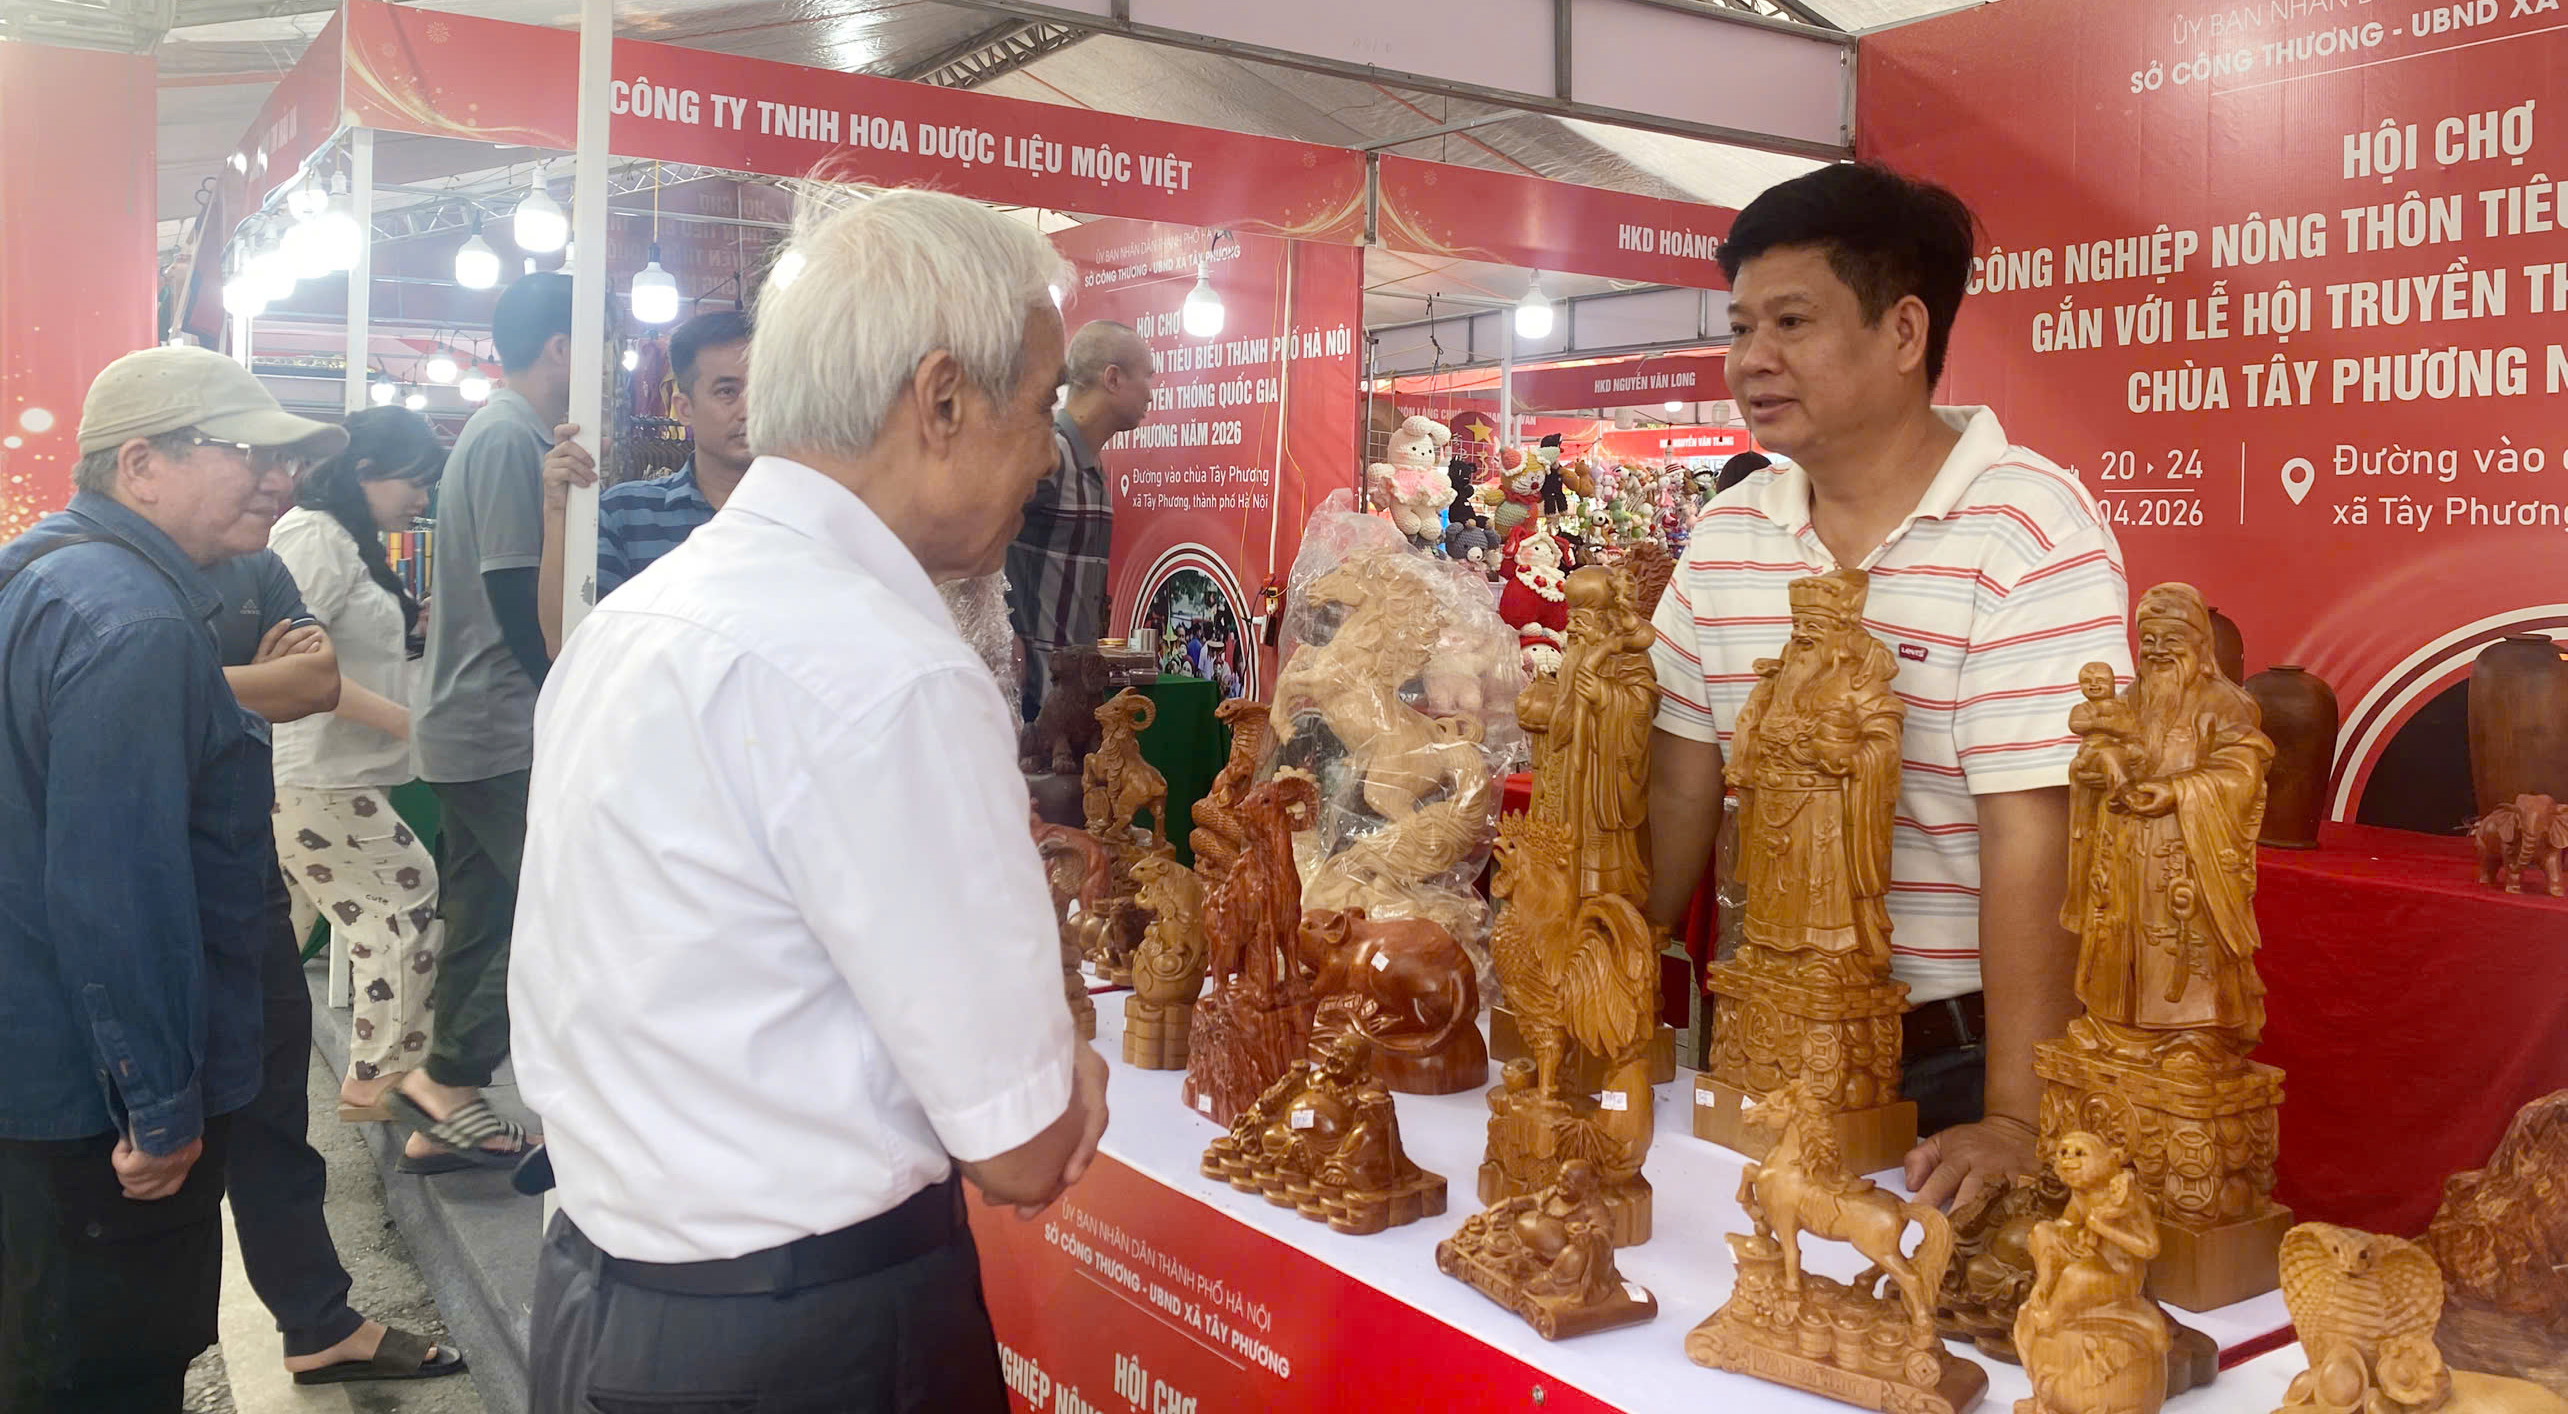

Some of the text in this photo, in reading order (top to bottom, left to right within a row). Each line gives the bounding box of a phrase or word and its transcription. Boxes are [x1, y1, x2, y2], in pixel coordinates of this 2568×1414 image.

[2210, 6, 2262, 37] BAN
[2129, 60, 2164, 94] SỞ
[2171, 51, 2254, 85] CÔNG
[2262, 21, 2384, 67] THƯƠNG
[2411, 0, 2499, 37] UBND
[610, 76, 1193, 195] CÔNG TY TNHH HOA DƯỢC LIỆU MỘC VIỆT
[2343, 99, 2536, 184] HỘI CHỢ
[1618, 223, 1719, 261] HKD HOÀNG
[1965, 245, 2053, 296] CÔNG
[2064, 223, 2199, 285] NGHIỆP
[2211, 211, 2327, 269] NÔNG
[2340, 190, 2463, 252] THÔN
[1095, 269, 1117, 285] CÔNG
[1118, 264, 1148, 280] THƯƠNG
[1153, 259, 1174, 274] UBND
[2031, 294, 2103, 353] GẮN
[2114, 293, 2173, 347] VỚI
[2186, 279, 2230, 341] LỄ
[2242, 279, 2312, 344] HỘI
[2325, 255, 2507, 330] TRUYỀN
[1136, 309, 1182, 344] HỘI CHỢ
[1167, 343, 1192, 374] TIÊU
[1195, 335, 1223, 370] BIỂU
[1226, 335, 1268, 367] THÀNH
[1302, 326, 1323, 359] HÀ
[1325, 322, 1351, 361] NỘI
[1176, 376, 1215, 410] THỐNG
[1219, 371, 1253, 409] QUỐC
[1256, 377, 1279, 404] GIA
[1594, 379, 1611, 393] HKD
[1613, 370, 1649, 391] NGUYỄN
[1671, 372, 1696, 388] LONG
[2127, 359, 2229, 414] CHÙA
[2241, 353, 2319, 409] TÂY
[2333, 344, 2528, 405] PHƯƠNG
[1133, 422, 1178, 449] PHƯƠNG
[1181, 418, 1209, 447] NĂM
[1212, 420, 1242, 445] 2026
[1132, 465, 1270, 488] Đường vào chùa Tây Phương
[2100, 450, 2136, 480] 20
[2166, 448, 2204, 479] 24
[2332, 443, 2458, 483] Đường
[2472, 435, 2546, 474] vào
[1132, 494, 1142, 508] xã
[1143, 493, 1156, 511] Tây
[1158, 494, 1191, 511] Phương,
[1192, 493, 1217, 508] thành
[1219, 492, 1236, 511] phố
[1253, 493, 1269, 510] Nội
[2098, 499, 2204, 526] 04.2026
[2332, 494, 2568, 533] xã Tây Phươn
[1076, 1208, 1098, 1237] BAN
[1158, 1252, 1195, 1291] THÀNH
[1197, 1274, 1224, 1305] PHỐ
[1225, 1290, 1244, 1318] HÀ
[1246, 1301, 1271, 1333] NỘI
[1045, 1222, 1059, 1247] SỞ
[1060, 1232, 1093, 1266] CÔNG
[1095, 1251, 1140, 1293] THƯƠNG
[1149, 1282, 1181, 1317] UBND
[1204, 1313, 1229, 1344] TÂY
[1231, 1328, 1290, 1379] PHƯƠNG
[998, 1342, 1050, 1412] GHIỆP
[1113, 1352, 1148, 1413] HỘI
